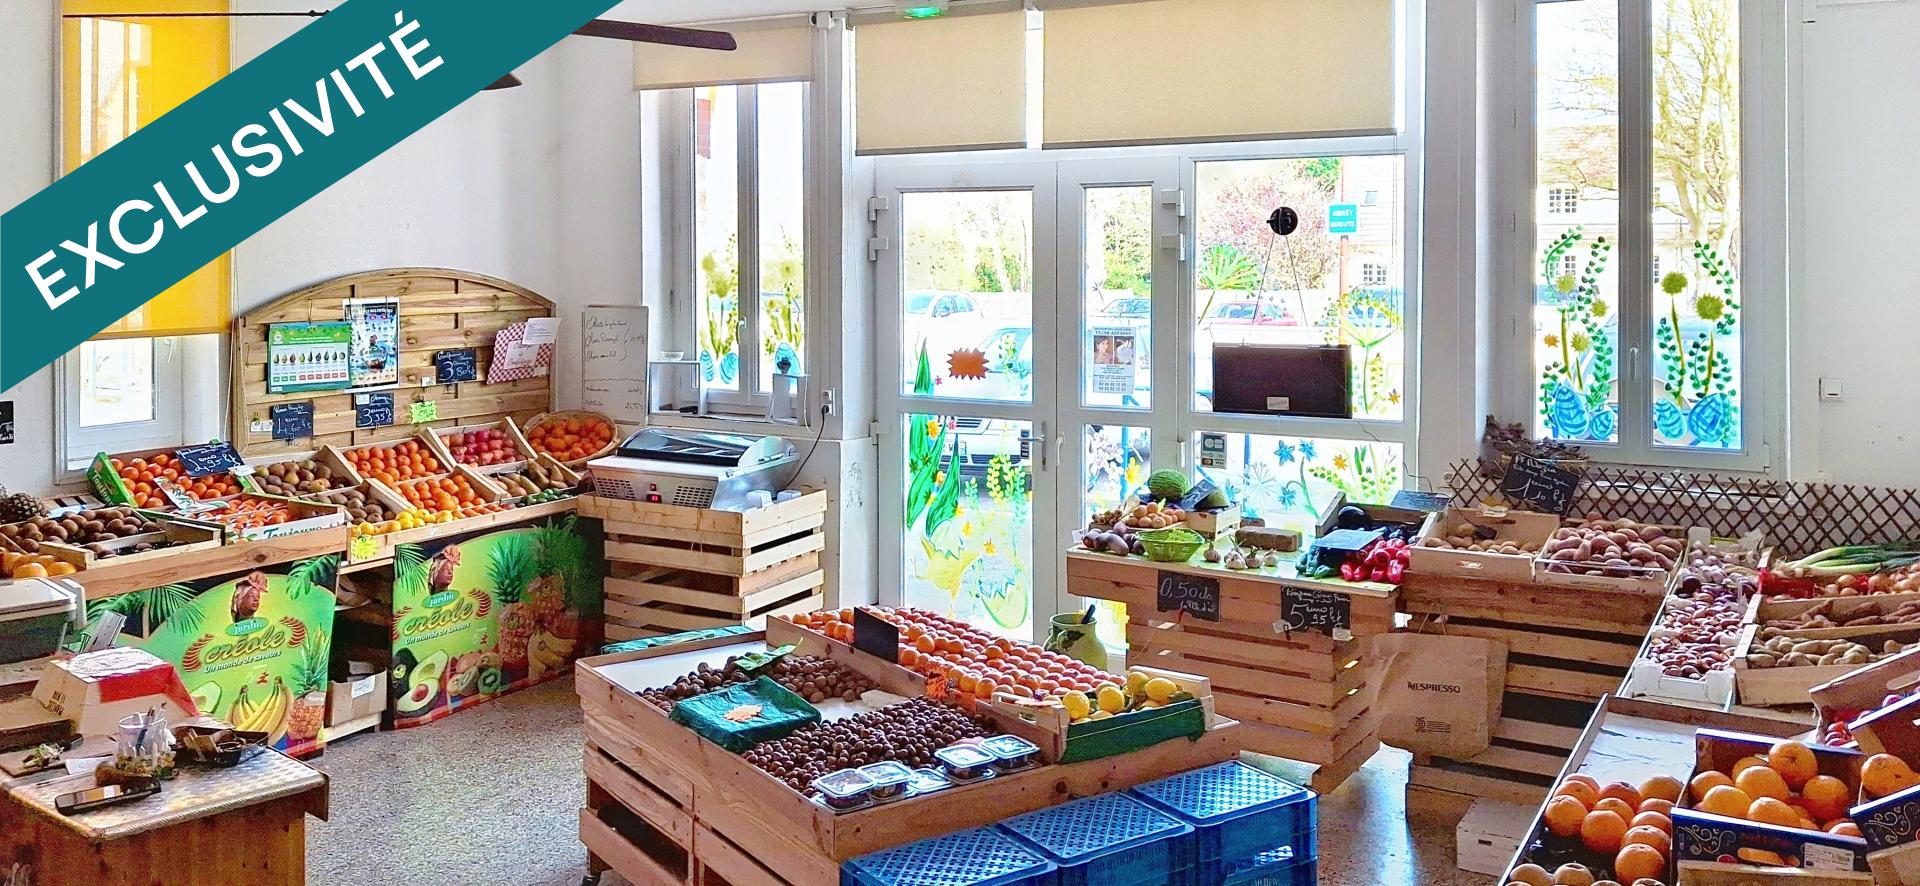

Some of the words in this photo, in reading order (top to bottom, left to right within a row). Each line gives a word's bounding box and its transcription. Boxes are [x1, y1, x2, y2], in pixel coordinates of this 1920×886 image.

[403, 596, 474, 636] créole
[205, 625, 286, 664] créole
[216, 660, 242, 671] monde
[242, 655, 254, 664] de
[1407, 681, 1461, 694] NESPRESSO
